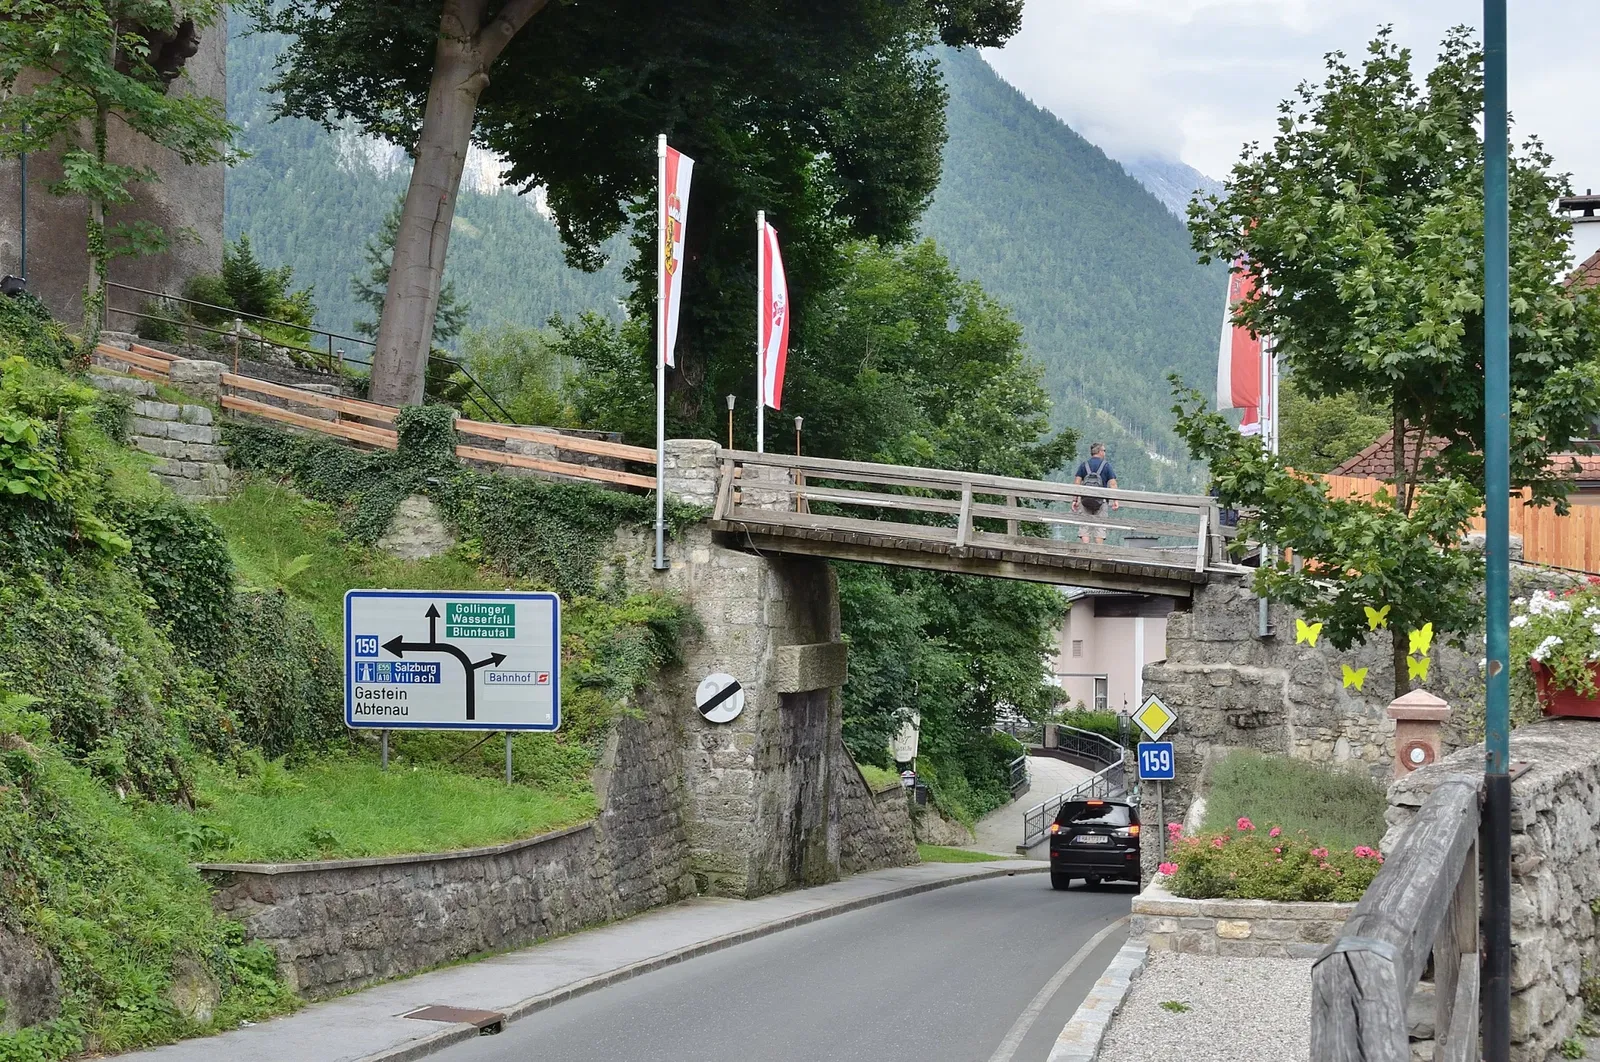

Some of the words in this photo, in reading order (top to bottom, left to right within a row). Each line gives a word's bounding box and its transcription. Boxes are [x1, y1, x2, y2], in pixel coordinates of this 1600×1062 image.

[456, 604, 506, 615] Gollinger
[452, 614, 510, 624] Wasserfall
[453, 627, 509, 637] Bluntautal
[356, 638, 377, 654] 159
[395, 662, 436, 674] Salzburg
[395, 673, 434, 682] Villach
[489, 673, 531, 682] Bahnhof
[355, 686, 407, 700] Gastein
[354, 702, 408, 716] Abtenau
[1142, 750, 1170, 772] 159
